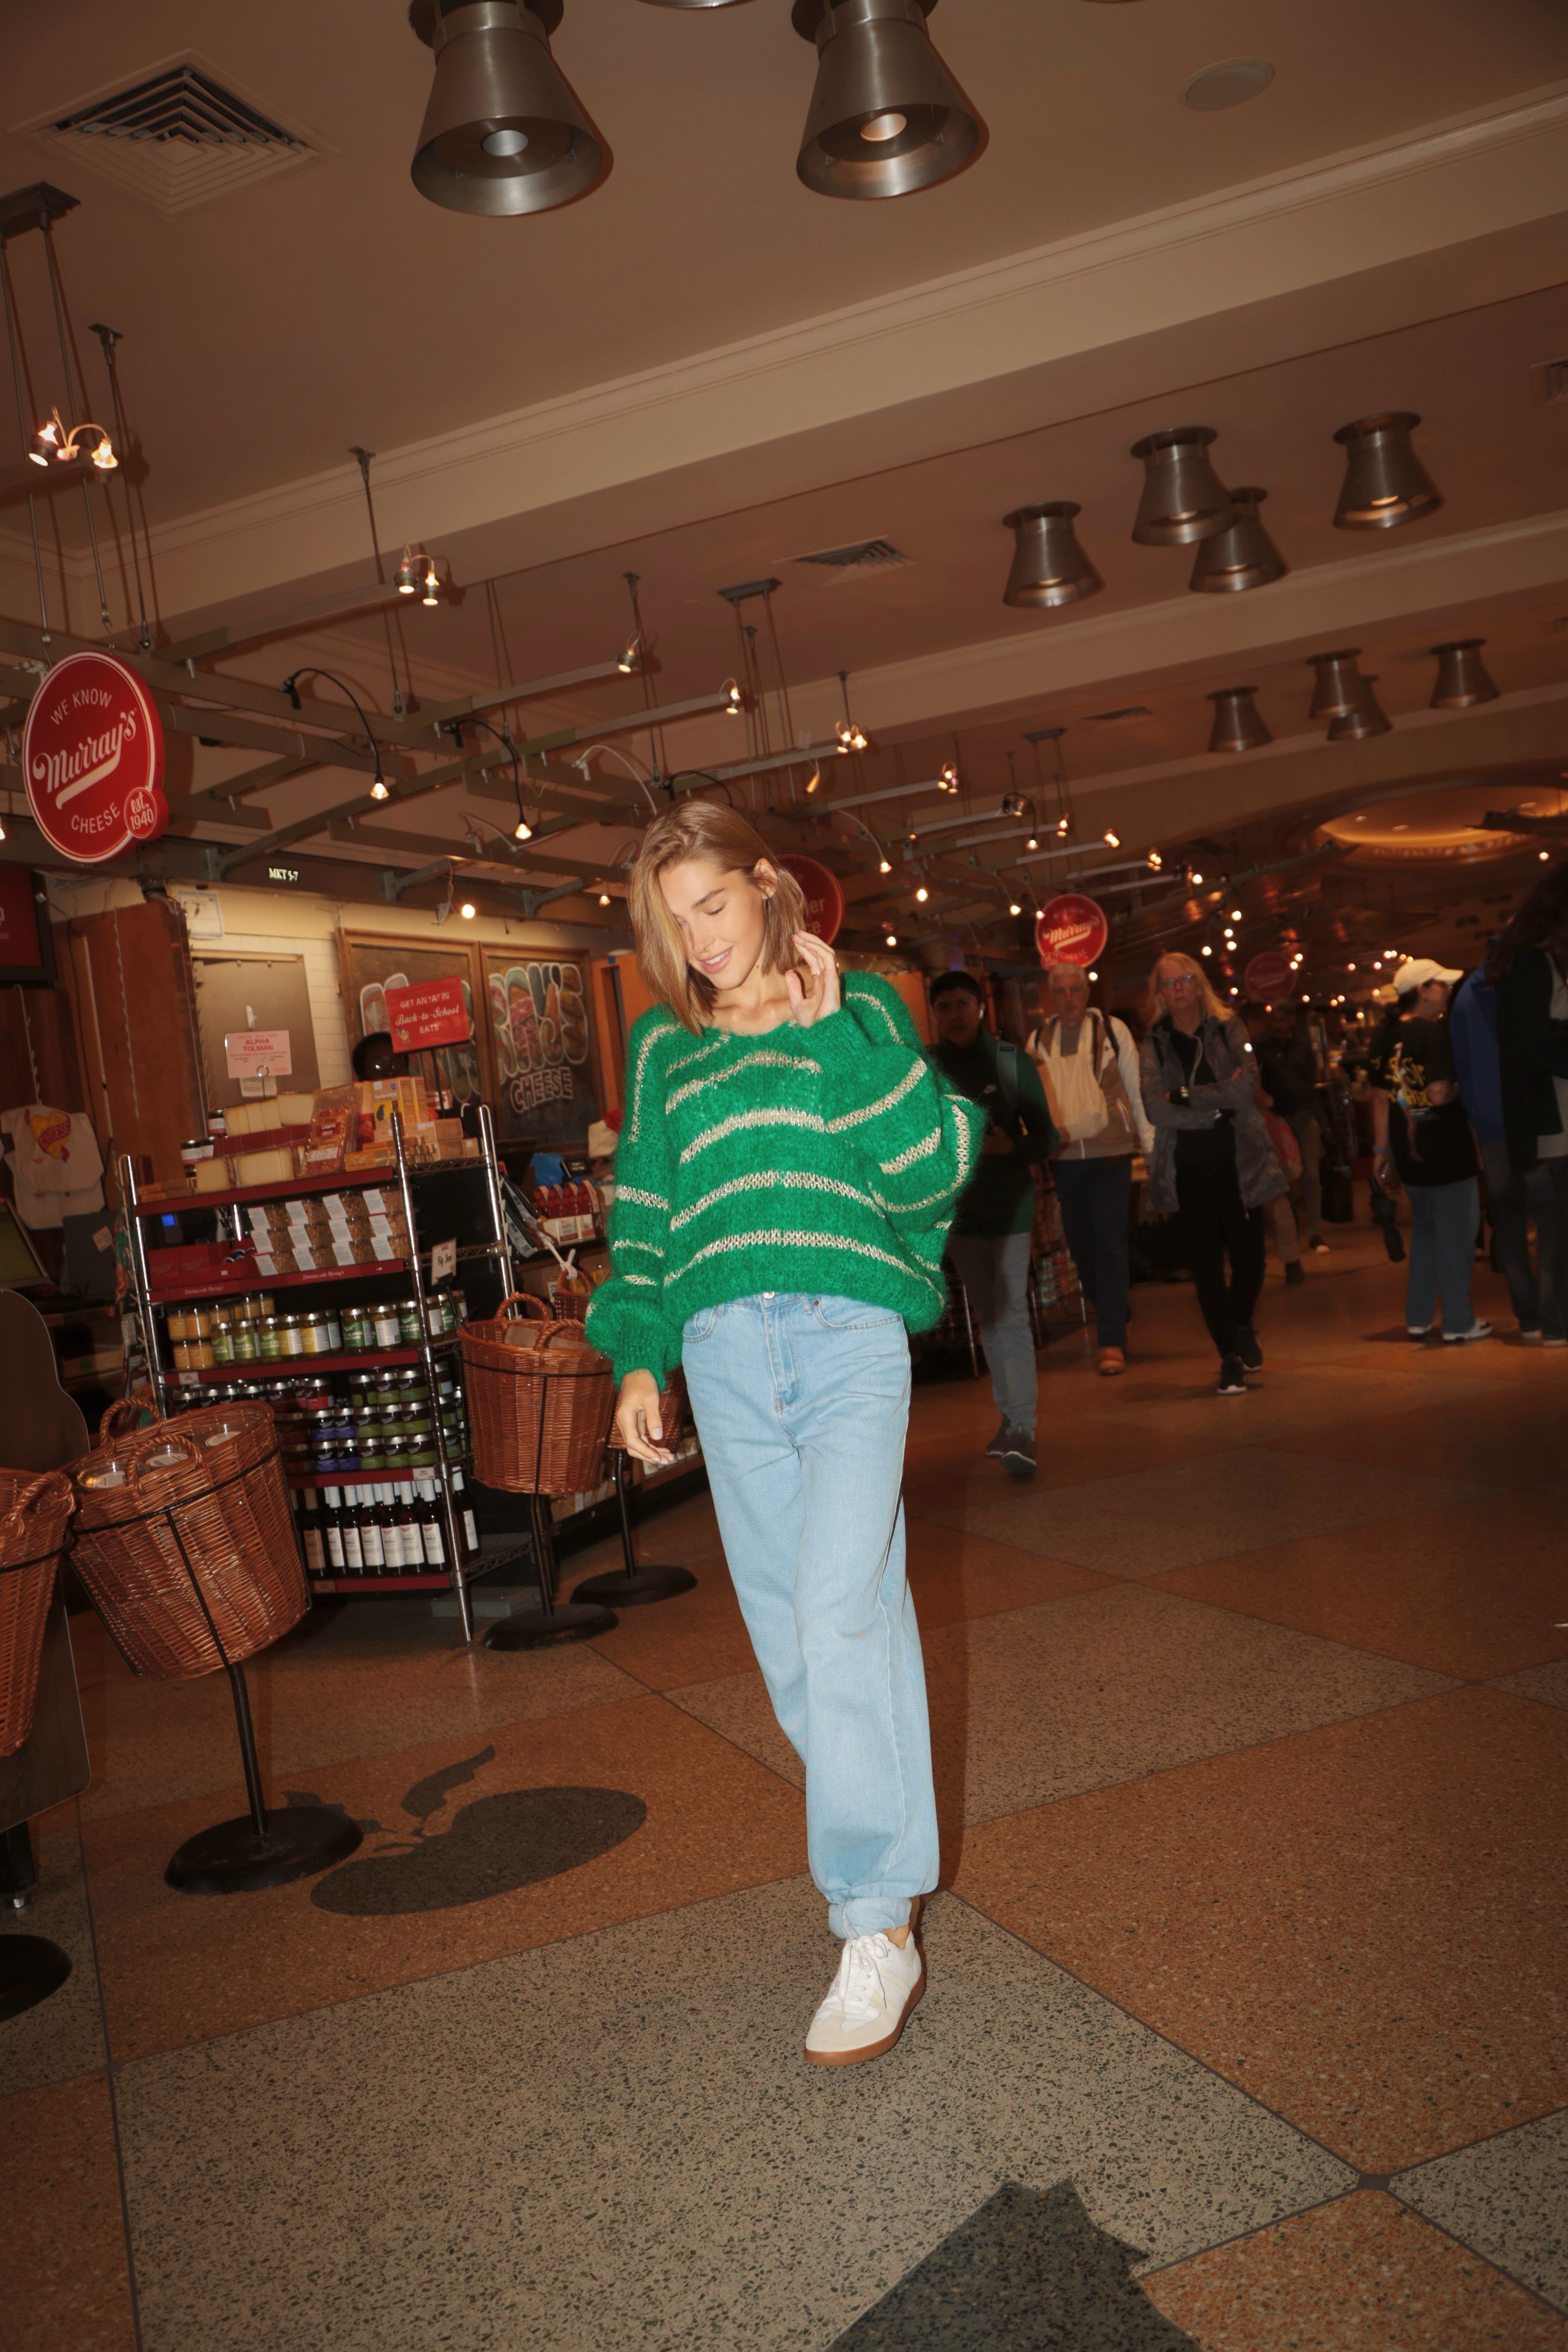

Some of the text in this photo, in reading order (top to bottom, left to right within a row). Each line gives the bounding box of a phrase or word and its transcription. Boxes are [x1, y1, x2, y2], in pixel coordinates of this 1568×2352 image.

[51, 688, 112, 725] WE KNOW
[33, 711, 137, 809] Murray's
[131, 791, 149, 812] est.
[71, 801, 120, 834] CHEESE
[130, 808, 154, 830] 1940
[268, 867, 287, 880] MKT
[1042, 916, 1100, 950] Murray's
[400, 999, 414, 1008] GET
[416, 996, 427, 1005] AN
[441, 991, 450, 1000] IN
[395, 1004, 459, 1026] Back-to-School
[419, 1023, 439, 1034] EATS
[509, 1066, 574, 1114] CHEESE
[40, 1122, 70, 1147] CHEESE
